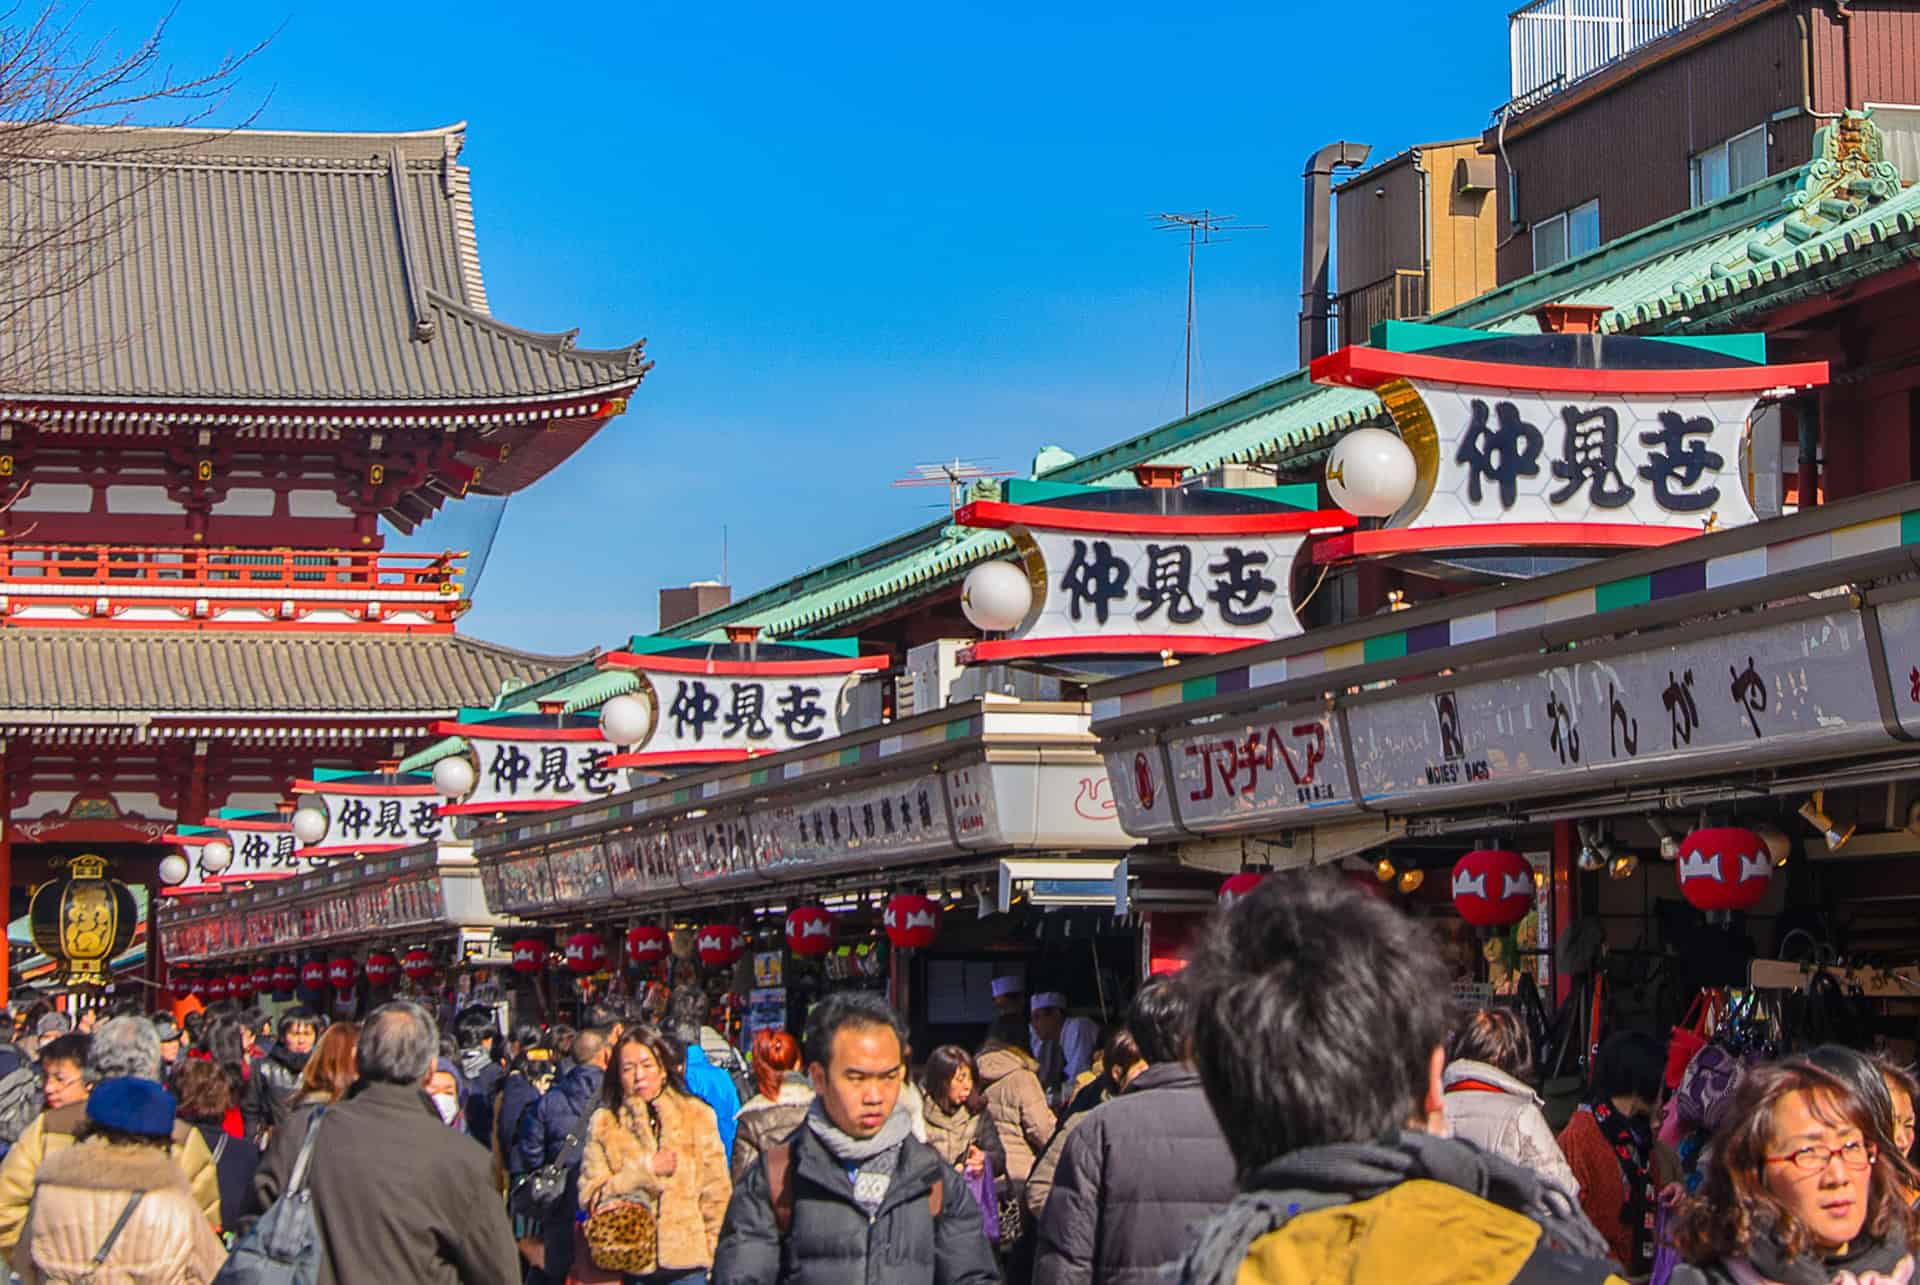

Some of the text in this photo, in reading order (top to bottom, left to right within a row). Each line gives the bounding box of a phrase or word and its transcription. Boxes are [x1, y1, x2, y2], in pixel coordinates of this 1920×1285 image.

[1456, 399, 1724, 511] 仲見世
[1061, 539, 1276, 626] 仲見世
[669, 680, 826, 741] 仲見世
[1547, 656, 1767, 765] れんがや
[489, 744, 617, 794] 仲見世
[338, 798, 443, 840] 仲見世
